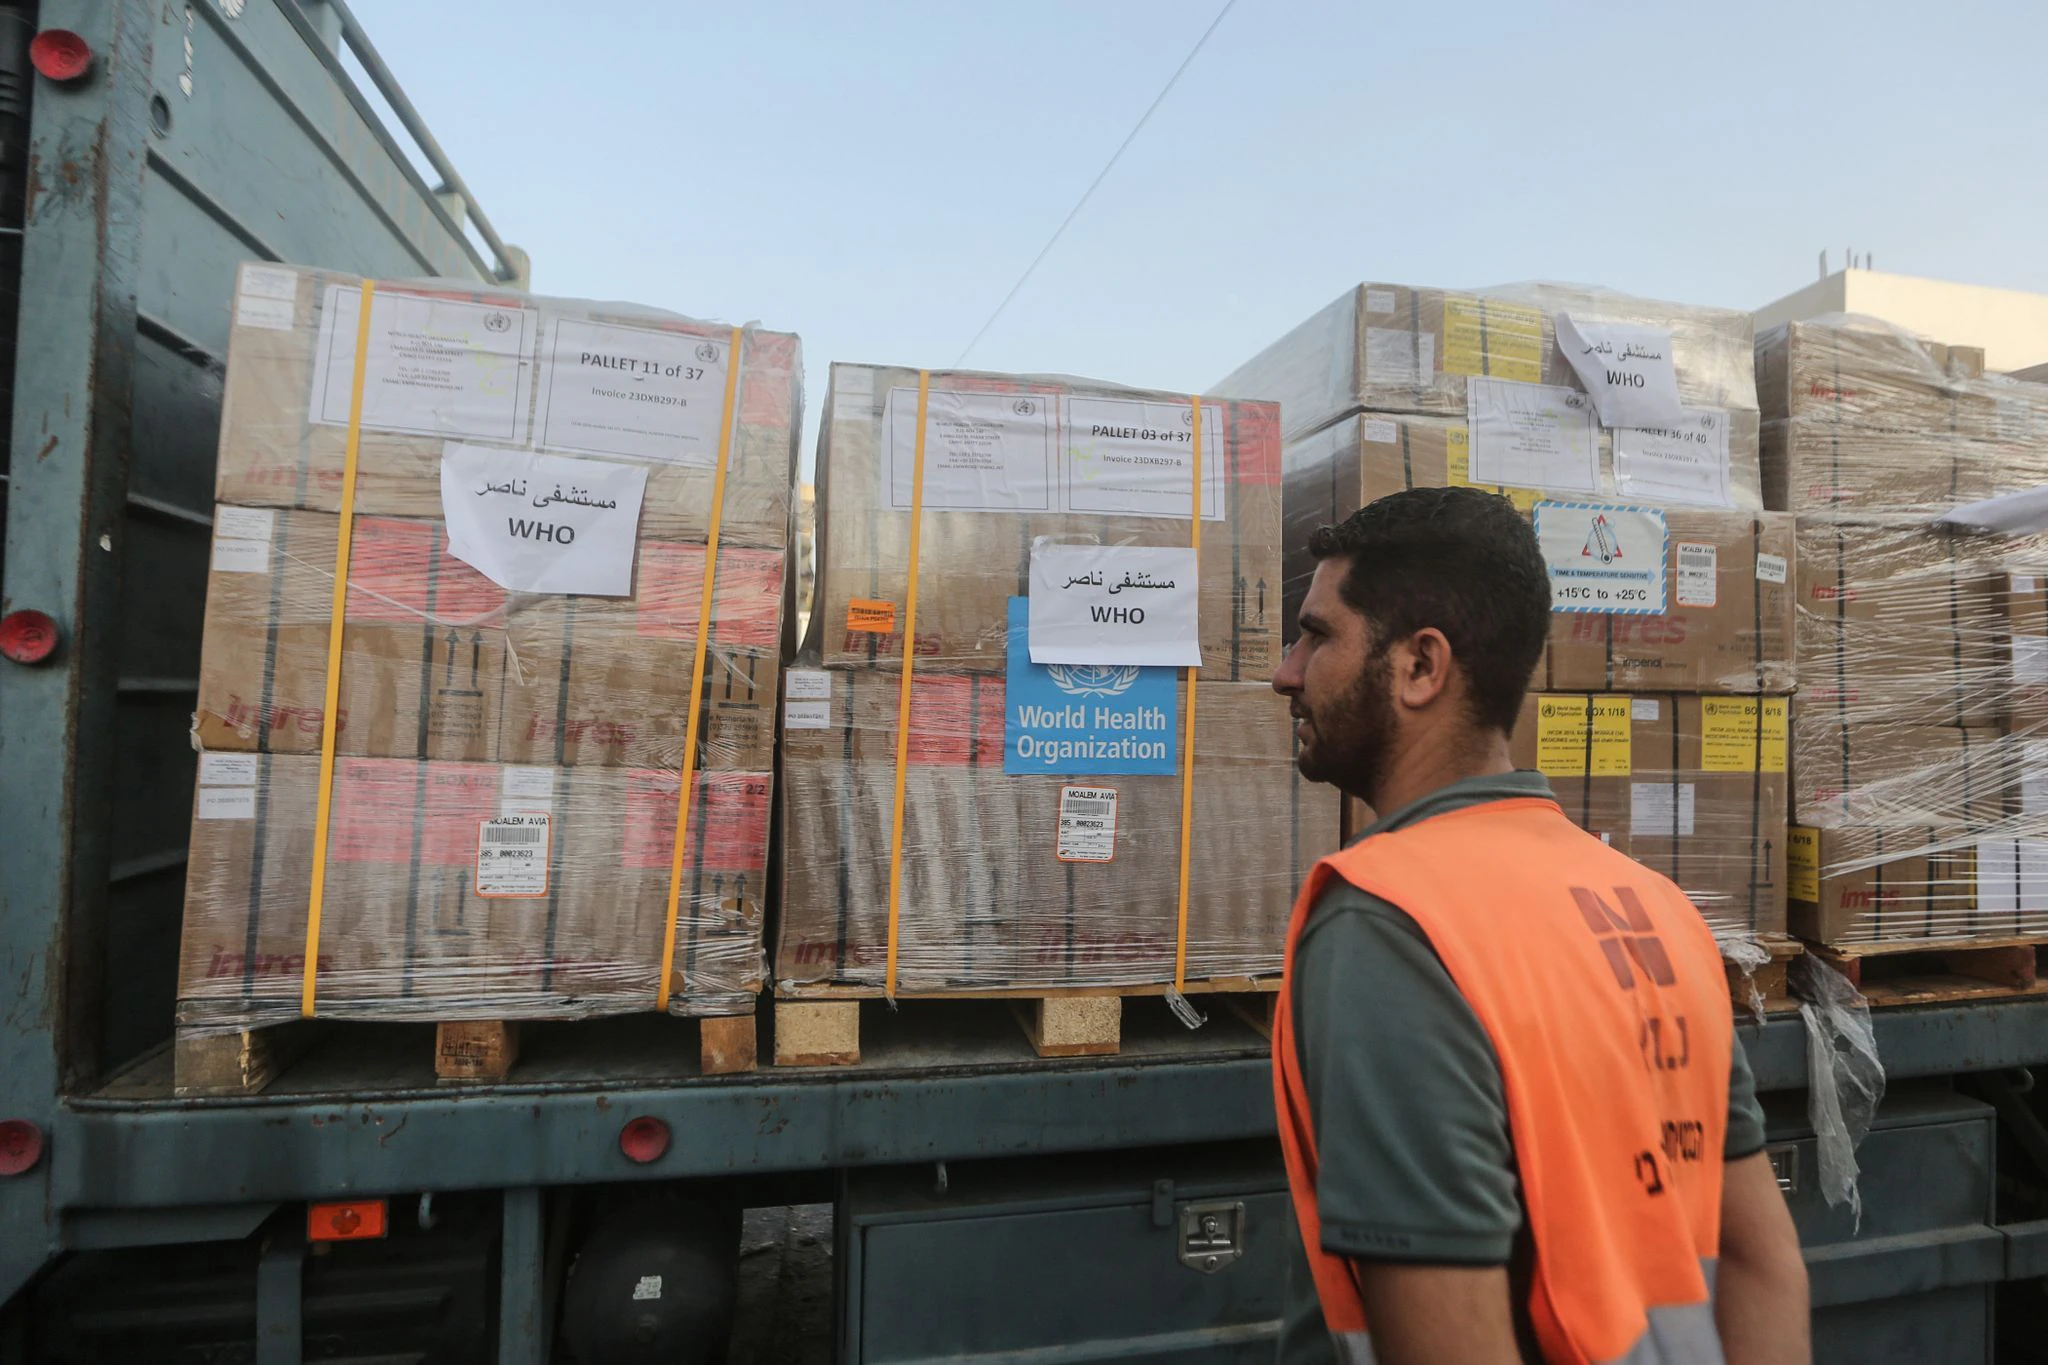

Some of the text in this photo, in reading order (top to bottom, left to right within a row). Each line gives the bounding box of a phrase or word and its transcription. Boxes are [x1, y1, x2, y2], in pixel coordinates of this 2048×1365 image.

[581, 352, 704, 381] PALLET 11 of 37
[1606, 369, 1645, 388] WHO
[592, 387, 687, 407] Invoice 23DXB297-B
[1092, 425, 1191, 442] PALLET 03 of 37
[1684, 432, 1694, 442] of
[1696, 433, 1707, 444] 40
[1103, 454, 1183, 466] Invoice 23DXB297-B
[475, 478, 617, 509] مستشفى ناصر
[508, 517, 575, 545] WHO
[1061, 571, 1175, 594] مستشفى ناصر
[1555, 569, 1569, 577] TIME
[1577, 570, 1618, 579] TEMPERATURE
[1620, 572, 1648, 580] SENSITIVE
[1597, 588, 1609, 600] to
[1091, 605, 1145, 625] WHO
[1018, 705, 1166, 730] World Health
[1608, 706, 1626, 717] 1/18
[1744, 706, 1759, 716] BO
[1017, 735, 1166, 765] Organization
[745, 783, 766, 796] 2/2
[1068, 790, 1097, 799] MOALEM
[489, 816, 524, 825] MOALEM
